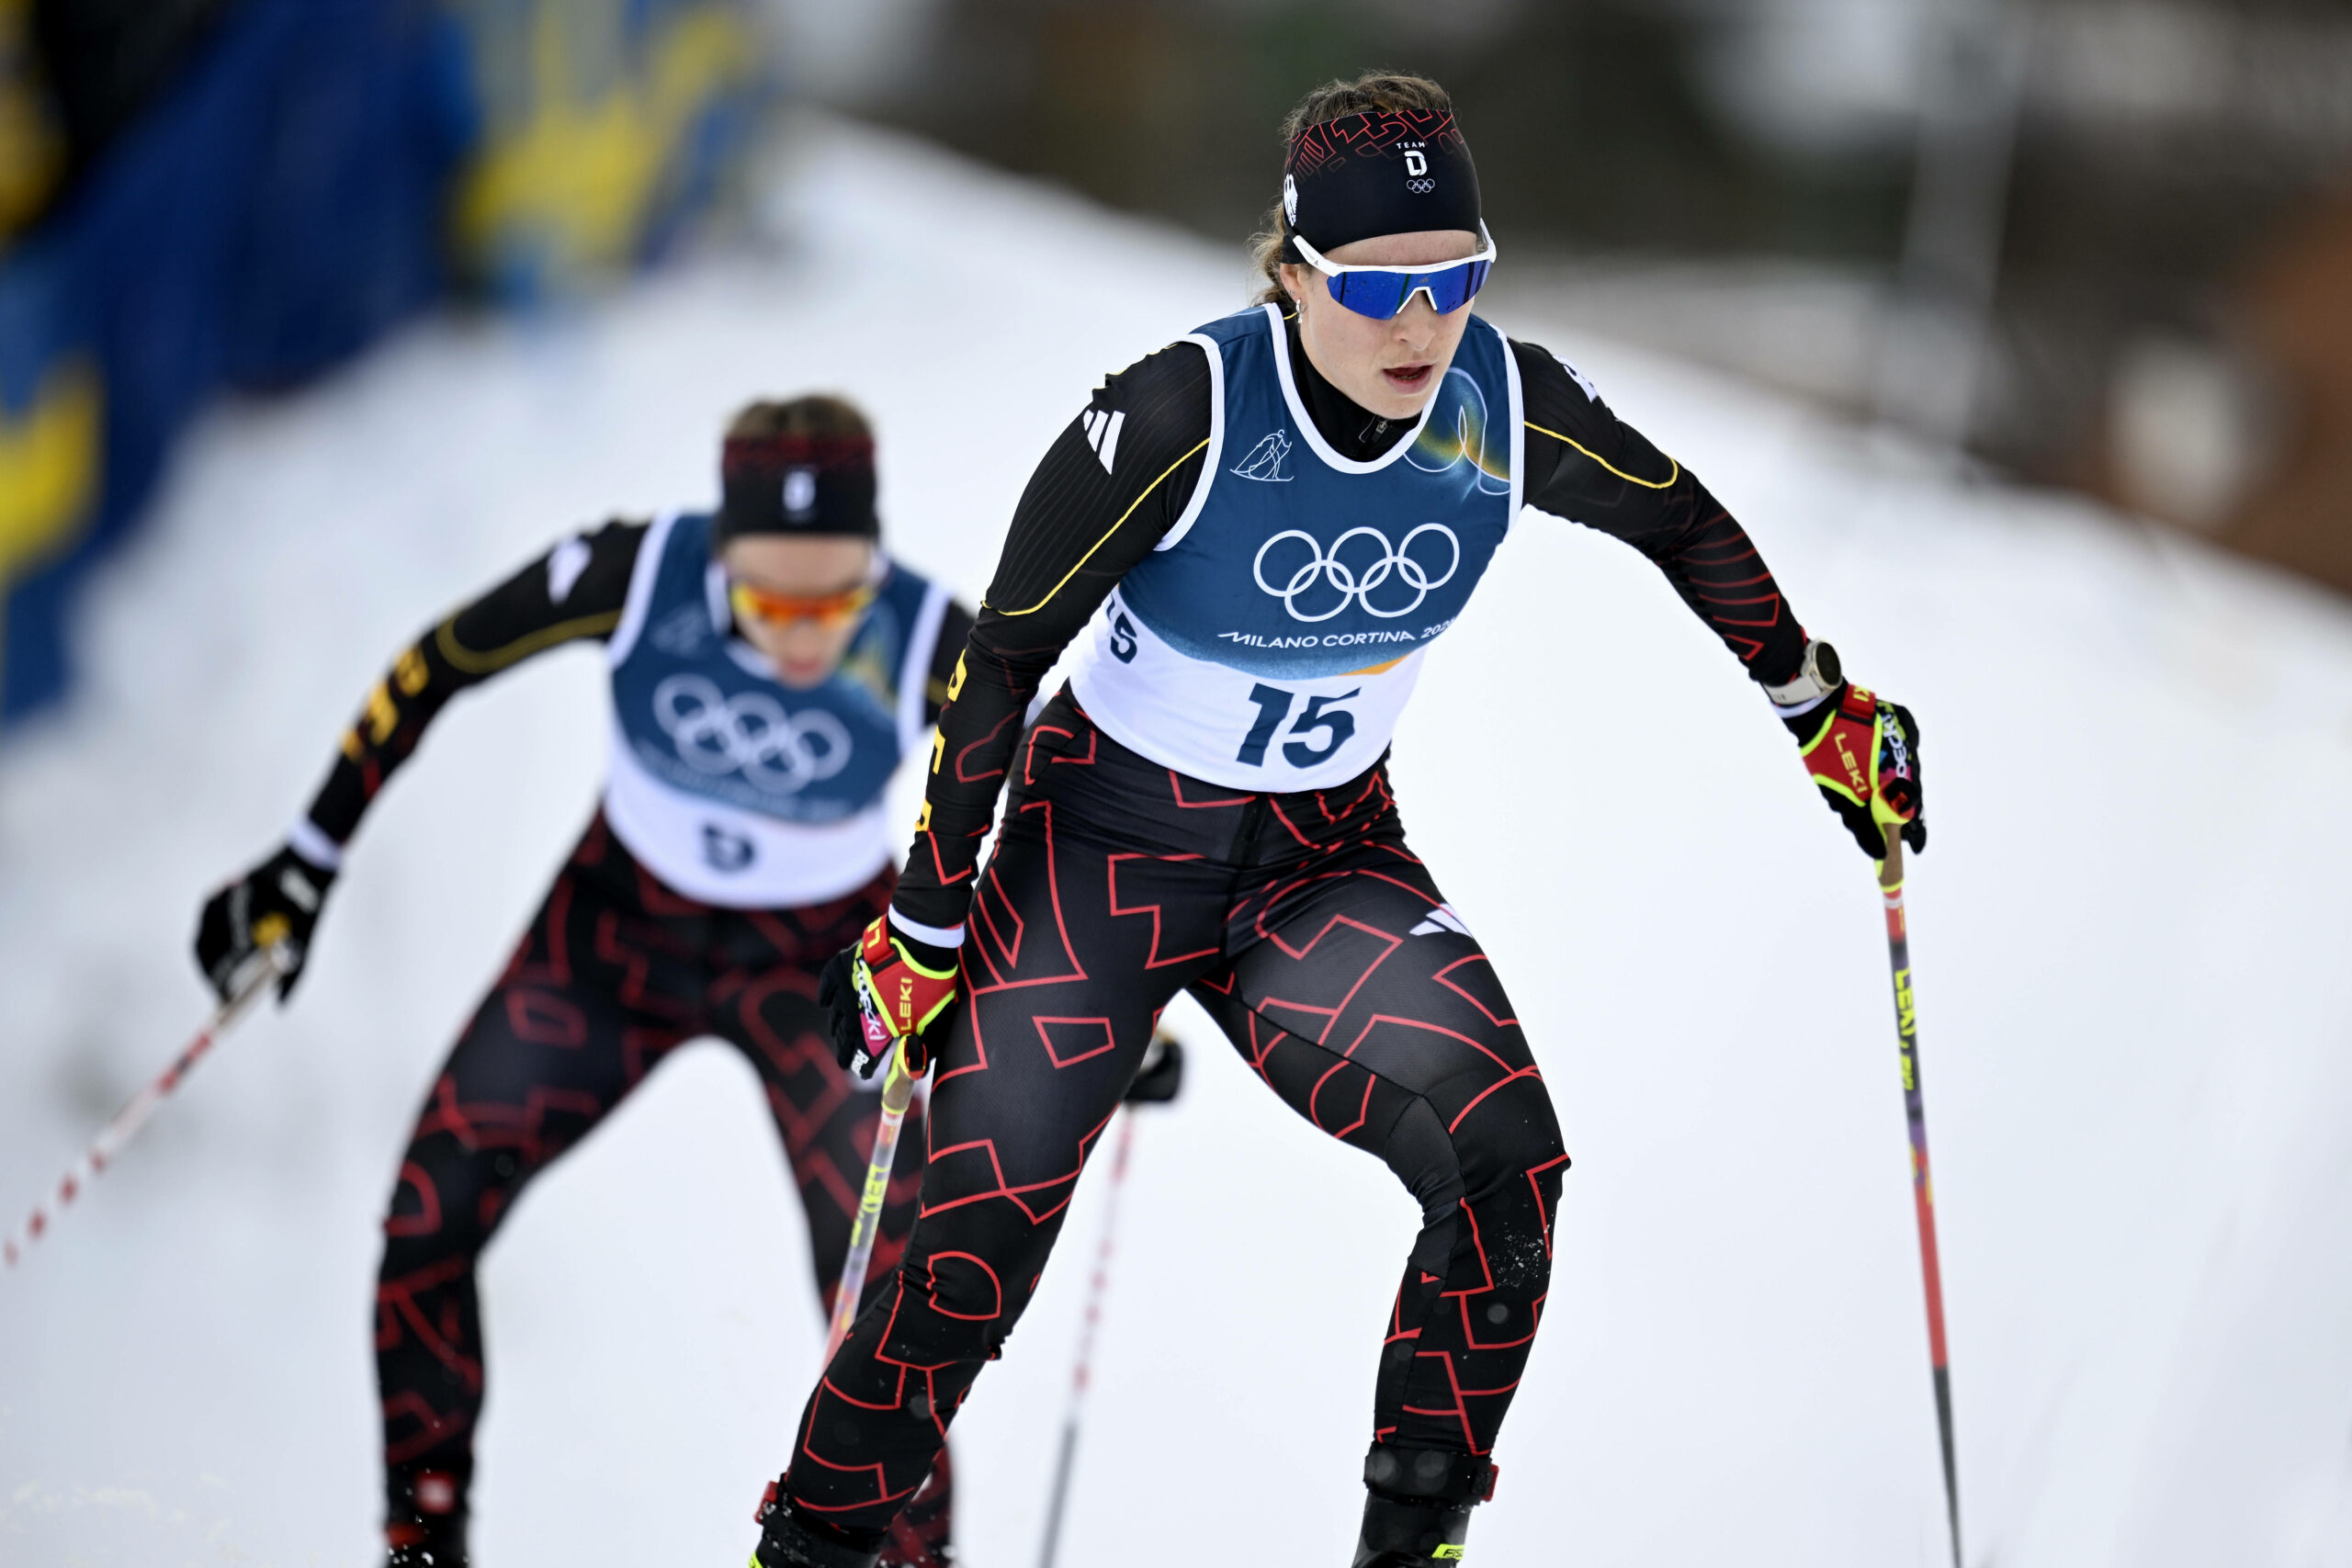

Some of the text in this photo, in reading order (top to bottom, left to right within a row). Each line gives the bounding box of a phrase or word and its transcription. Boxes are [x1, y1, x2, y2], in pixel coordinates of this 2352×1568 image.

[1396, 141, 1425, 150] TEAM
[1217, 631, 1318, 649] MILANO
[1322, 630, 1416, 647] CORTINA
[1236, 682, 1362, 769] 15
[1834, 732, 1868, 794] LEKI
[899, 976, 913, 1031] LEKI
